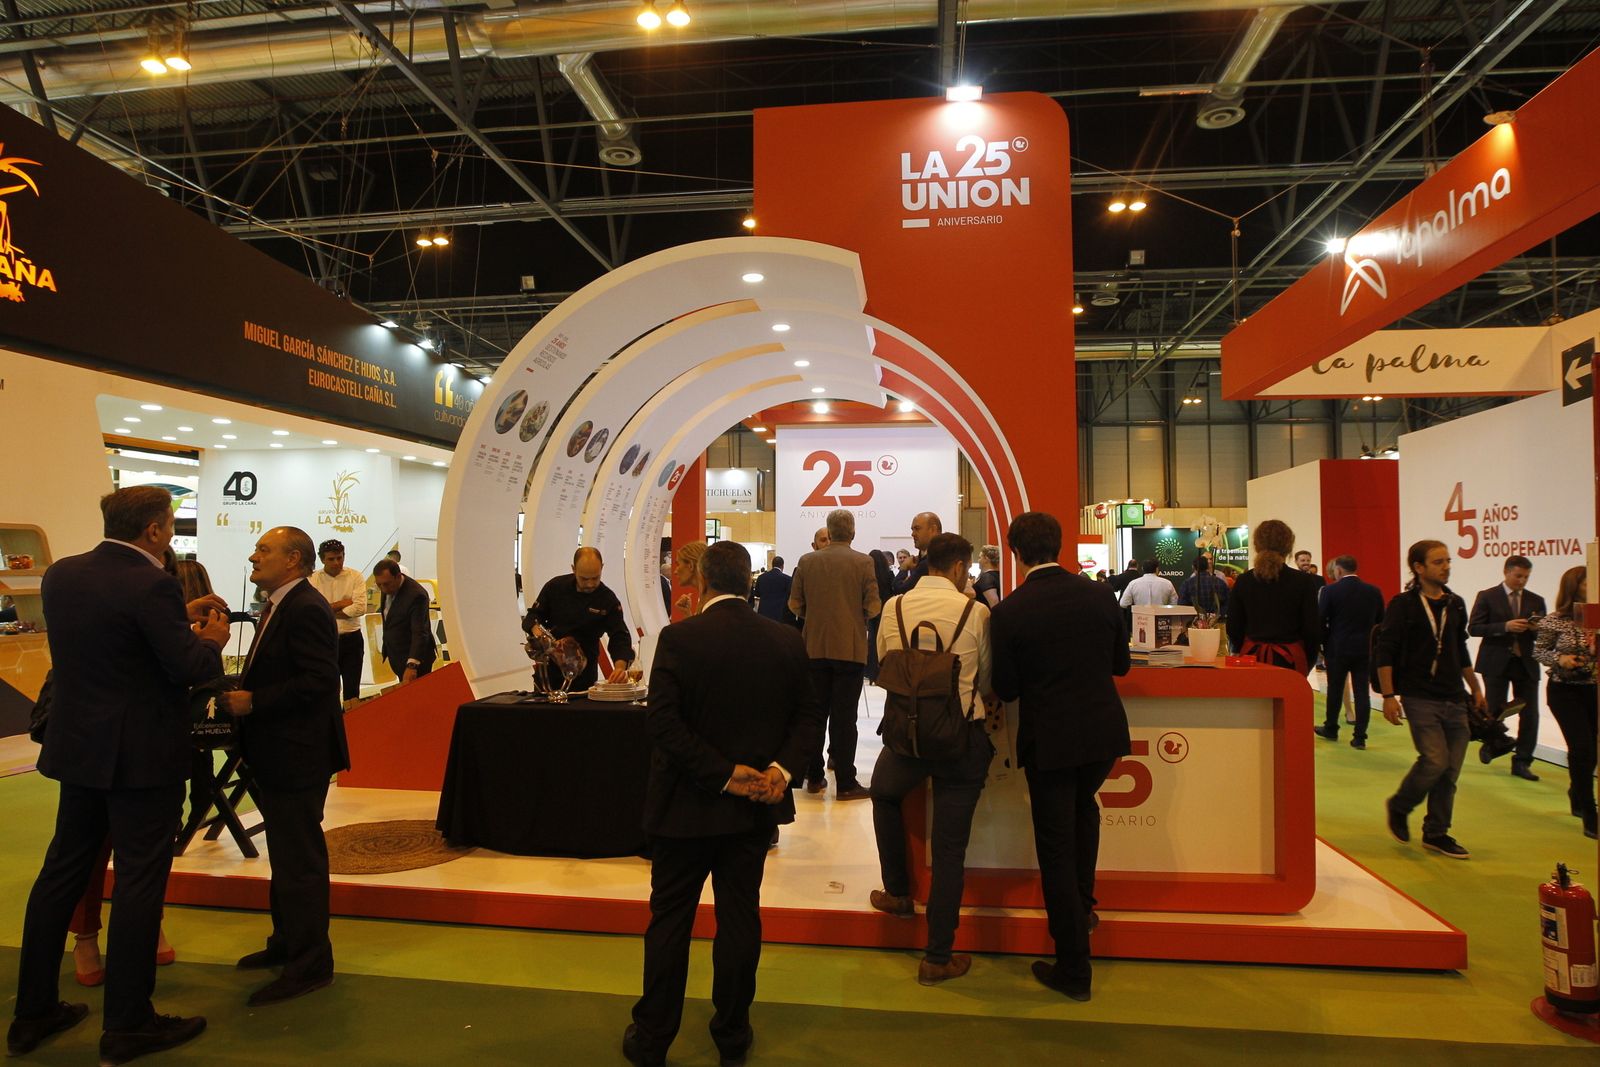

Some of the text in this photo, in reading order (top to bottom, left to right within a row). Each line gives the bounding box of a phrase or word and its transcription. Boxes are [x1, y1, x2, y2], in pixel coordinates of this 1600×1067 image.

[901, 134, 1012, 181] LA 25
[901, 177, 1031, 212] UNION
[937, 215, 1003, 227] ANIVERSARIO
[244, 320, 281, 350] MIGUEL
[283, 334, 315, 362] GARCÍA
[316, 345, 353, 373] SÁNCHEZ
[354, 359, 360, 375] E
[383, 367, 397, 387] S.A.
[1366, 344, 1490, 383] palma
[308, 368, 397, 409] EUROCASTELL CAÑA S.L.
[223, 471, 258, 501] 40
[801, 449, 875, 507] 25
[317, 515, 332, 525] LA
[800, 509, 877, 519] ANIVRIO
[1482, 503, 1519, 523] AÑOS
[1483, 525, 1499, 541] EN
[1483, 538, 1583, 558] COOPERATIVA
[1098, 740, 1153, 808] 5
